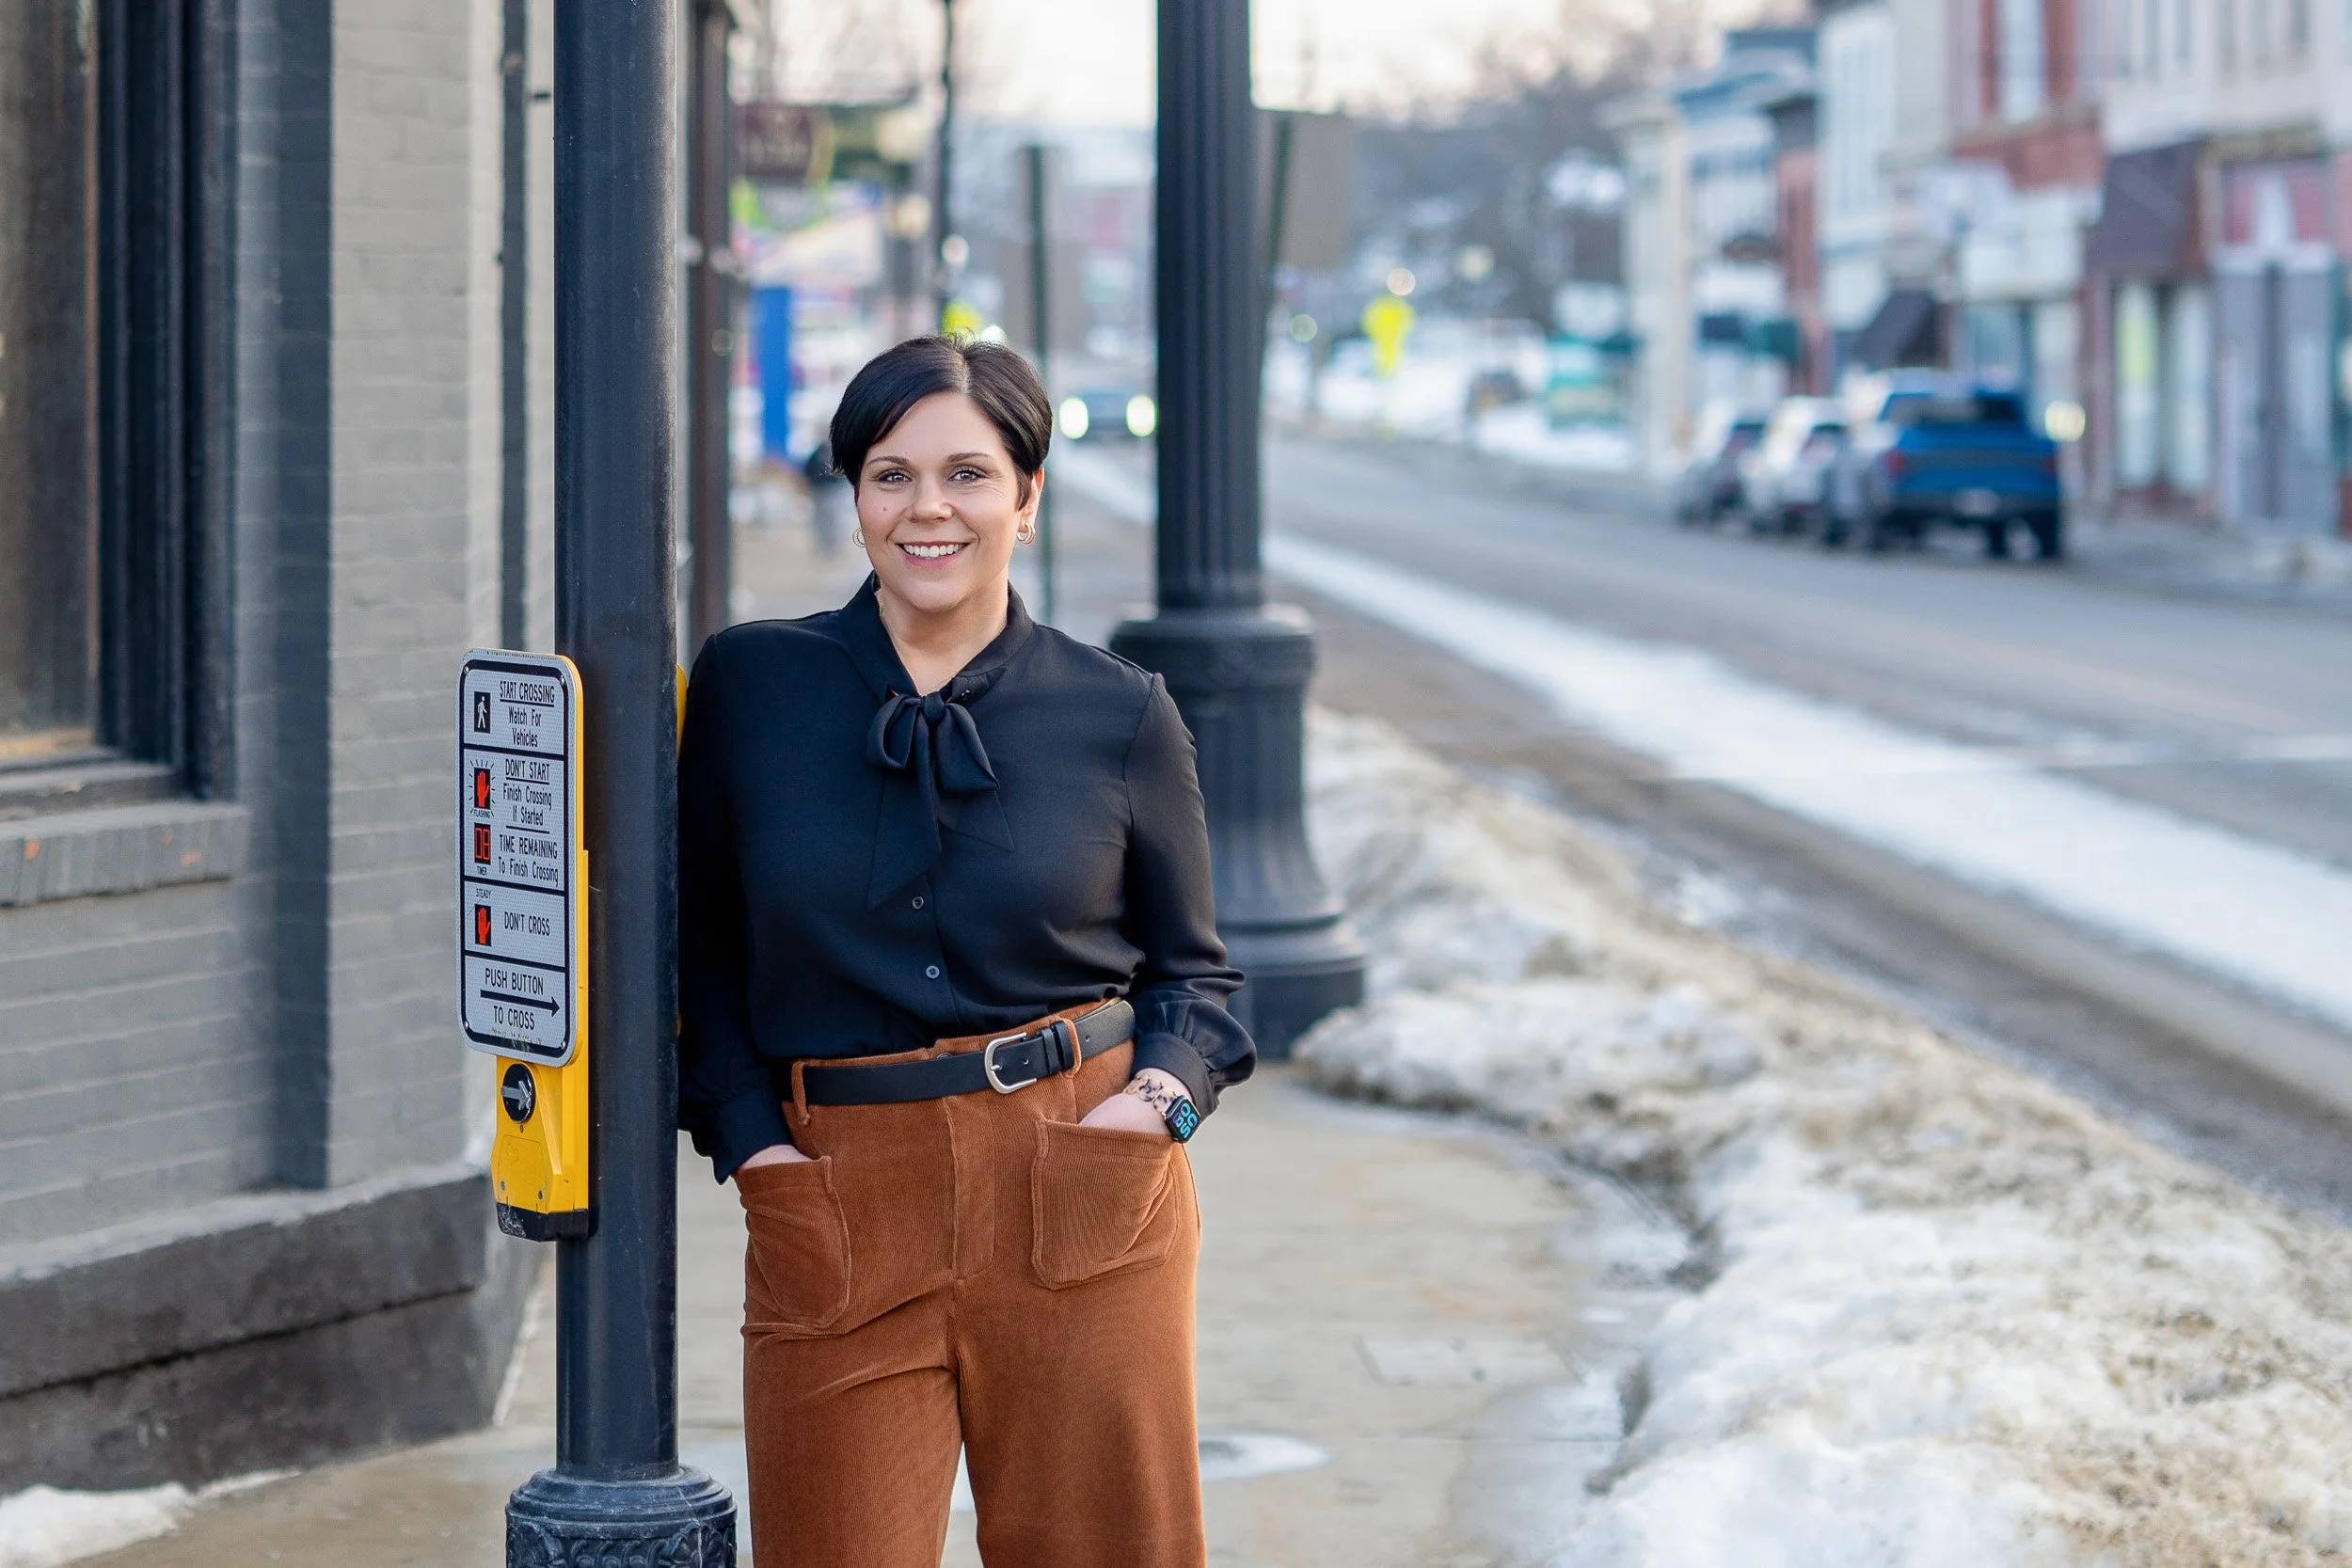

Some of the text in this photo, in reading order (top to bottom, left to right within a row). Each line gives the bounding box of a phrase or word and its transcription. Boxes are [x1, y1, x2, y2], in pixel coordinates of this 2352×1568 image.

[500, 680, 555, 704] START CROSSING
[509, 705, 542, 726] Watch For
[512, 727, 538, 748] Vehicles
[505, 758, 550, 781] DON'T START
[502, 783, 552, 812] Finish Crossing
[520, 805, 544, 826] Started
[499, 833, 558, 860] TIME REMAINING
[498, 856, 559, 888] To Finish Crossing
[475, 888, 492, 899] STEADY
[504, 911, 550, 937] DON'T CROSS
[485, 967, 544, 996] PUSH BUTTON
[493, 1005, 535, 1031] TO CROSS
